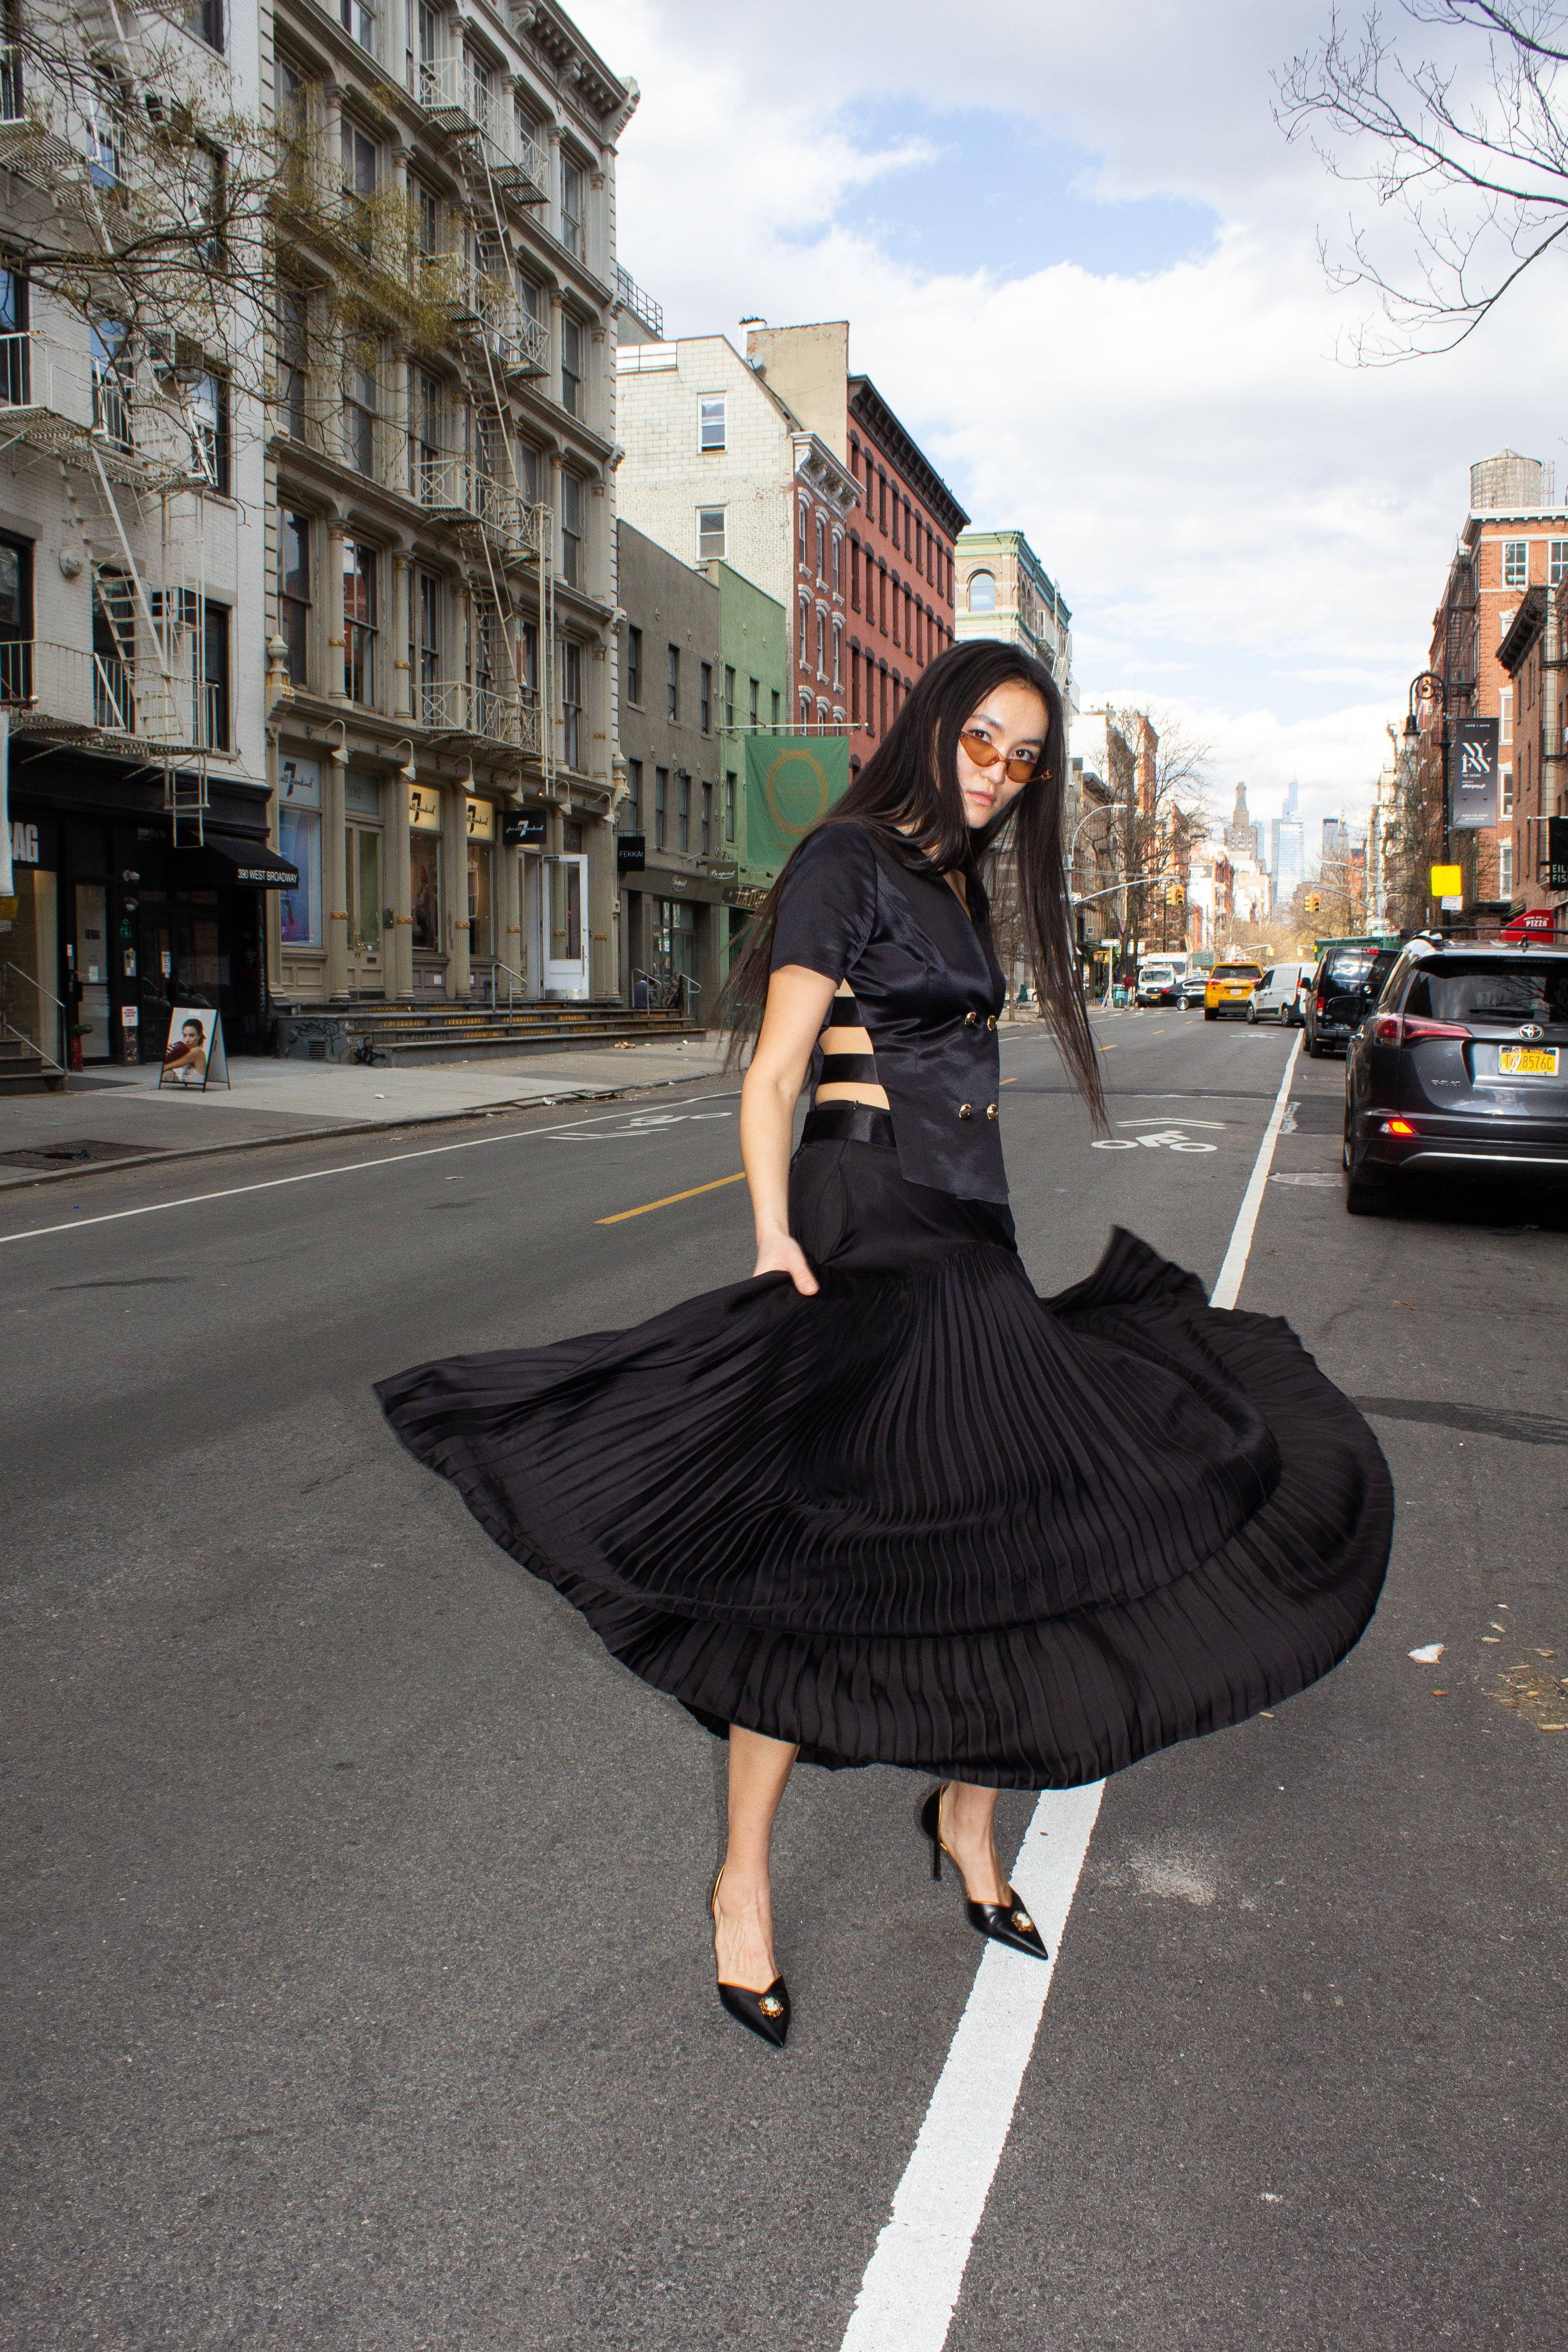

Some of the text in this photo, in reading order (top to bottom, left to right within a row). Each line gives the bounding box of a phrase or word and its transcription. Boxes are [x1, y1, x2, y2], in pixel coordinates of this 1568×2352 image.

[283, 762, 297, 797] 7
[412, 792, 421, 823] 7
[467, 804, 476, 834] 7
[518, 820, 529, 837] 7
[238, 868, 298, 883] 390 WEST BROADWAY
[1552, 864, 1568, 873] EIL
[1553, 874, 1568, 883] FIS
